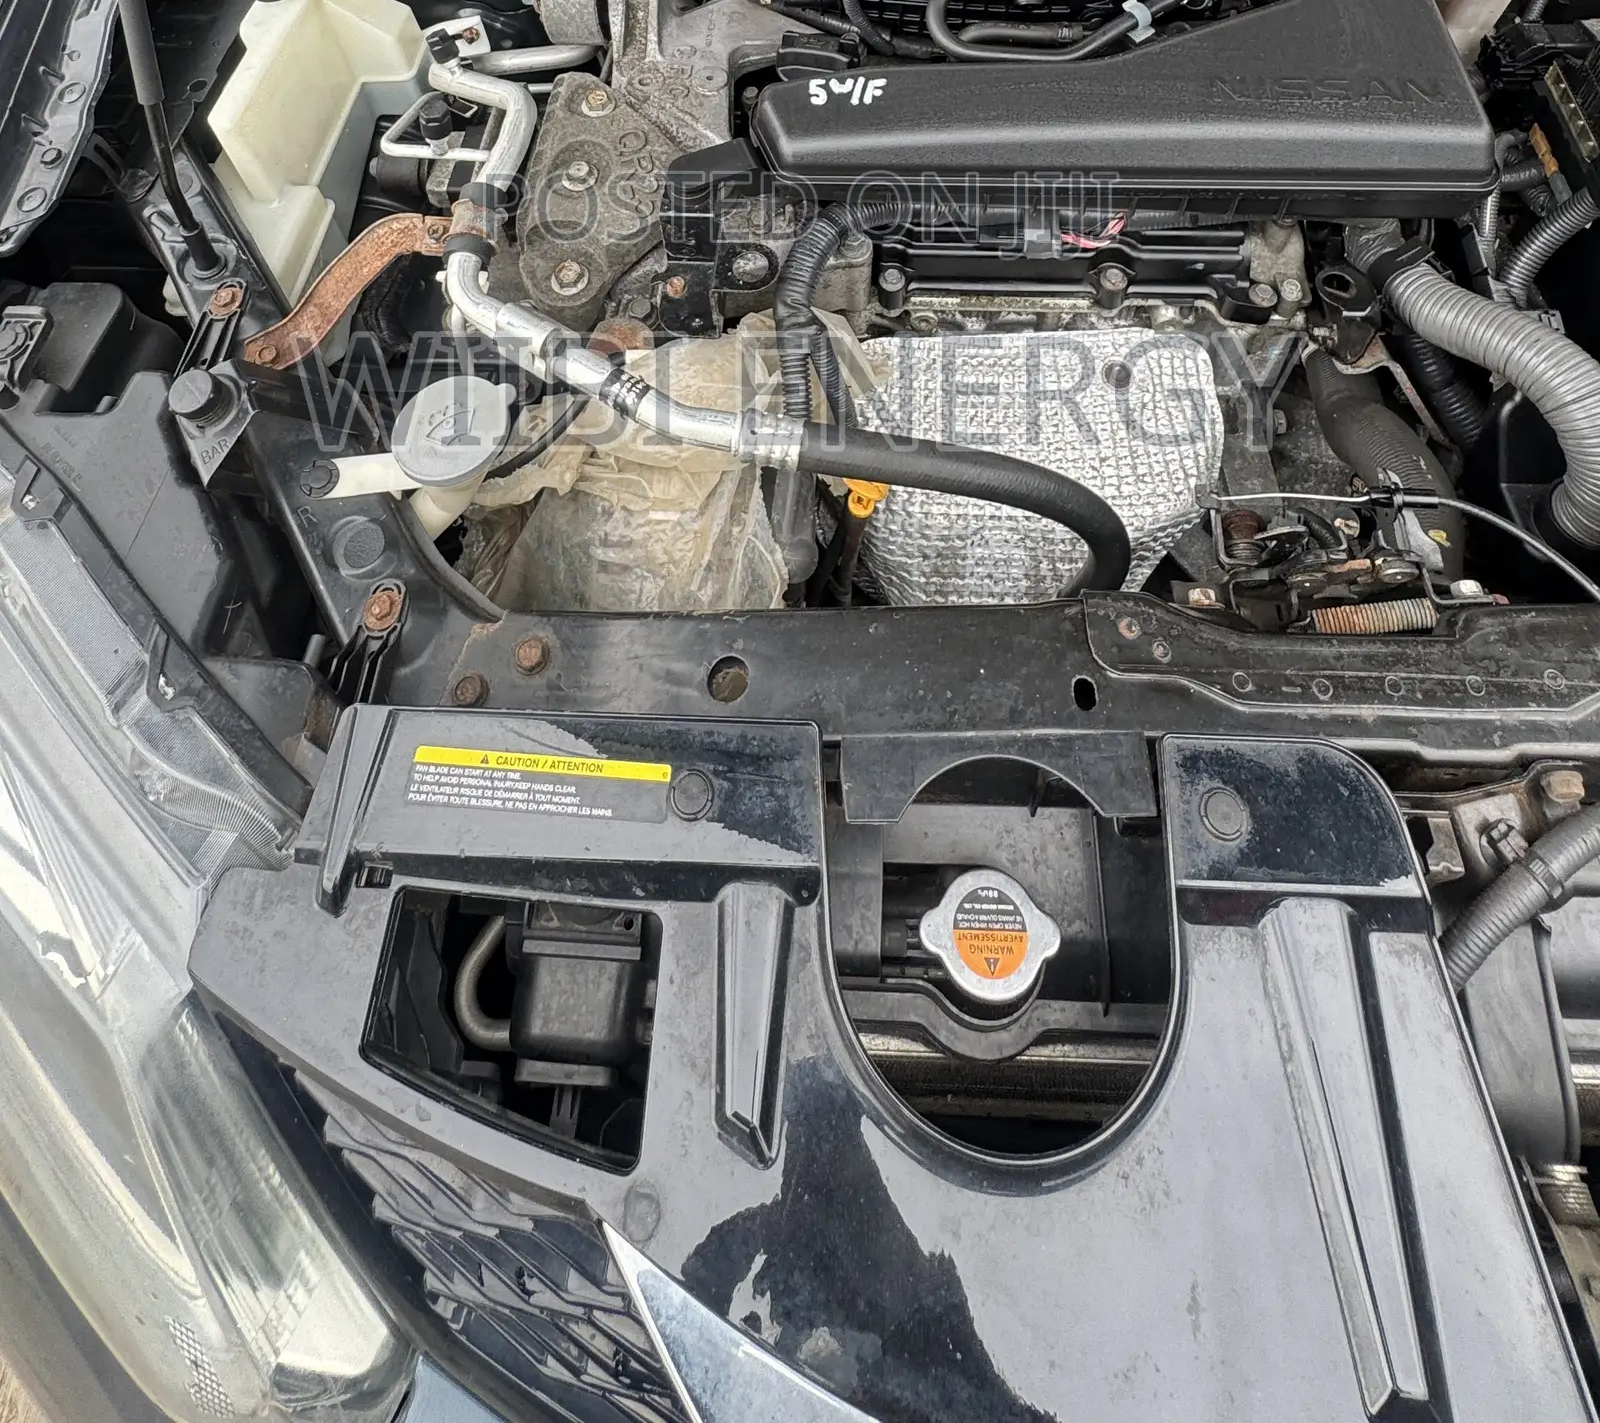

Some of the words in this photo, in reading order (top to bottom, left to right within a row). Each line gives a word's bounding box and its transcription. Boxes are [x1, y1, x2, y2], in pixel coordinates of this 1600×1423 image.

[1212, 77, 1448, 104] NISSAN
[200, 437, 230, 466] BAR
[415, 764, 428, 772] FAN
[428, 766, 449, 775] BLADE
[449, 767, 463, 775] CAN
[464, 768, 483, 777] START
[483, 769, 492, 778] AT
[492, 770, 505, 778] ANY
[496, 755, 540, 768] CAUTION
[541, 760, 549, 769] /
[549, 759, 604, 774] ATTENTION
[414, 773, 423, 781] TO
[422, 774, 439, 782] HELP
[440, 775, 459, 784] AVOID
[459, 777, 492, 787] PERSONAL
[531, 782, 554, 792] HANDS
[410, 783, 419, 792] LE
[420, 784, 459, 795] VENTILATEUR
[460, 786, 483, 796] RISQUE
[484, 789, 493, 797] DE
[535, 793, 551, 802] TOUT
[408, 792, 426, 801] POUR
[449, 795, 469, 805] TOUTE
[504, 800, 514, 808] NE
[514, 801, 528, 810] PAS
[528, 802, 538, 811] EN
[538, 802, 578, 814] APPROCHER
[578, 806, 591, 816] LES
[1004, 922, 1023, 930] NEVER
[957, 932, 1024, 943] AVERTISSEMENT
[969, 944, 1014, 955] WARNING
